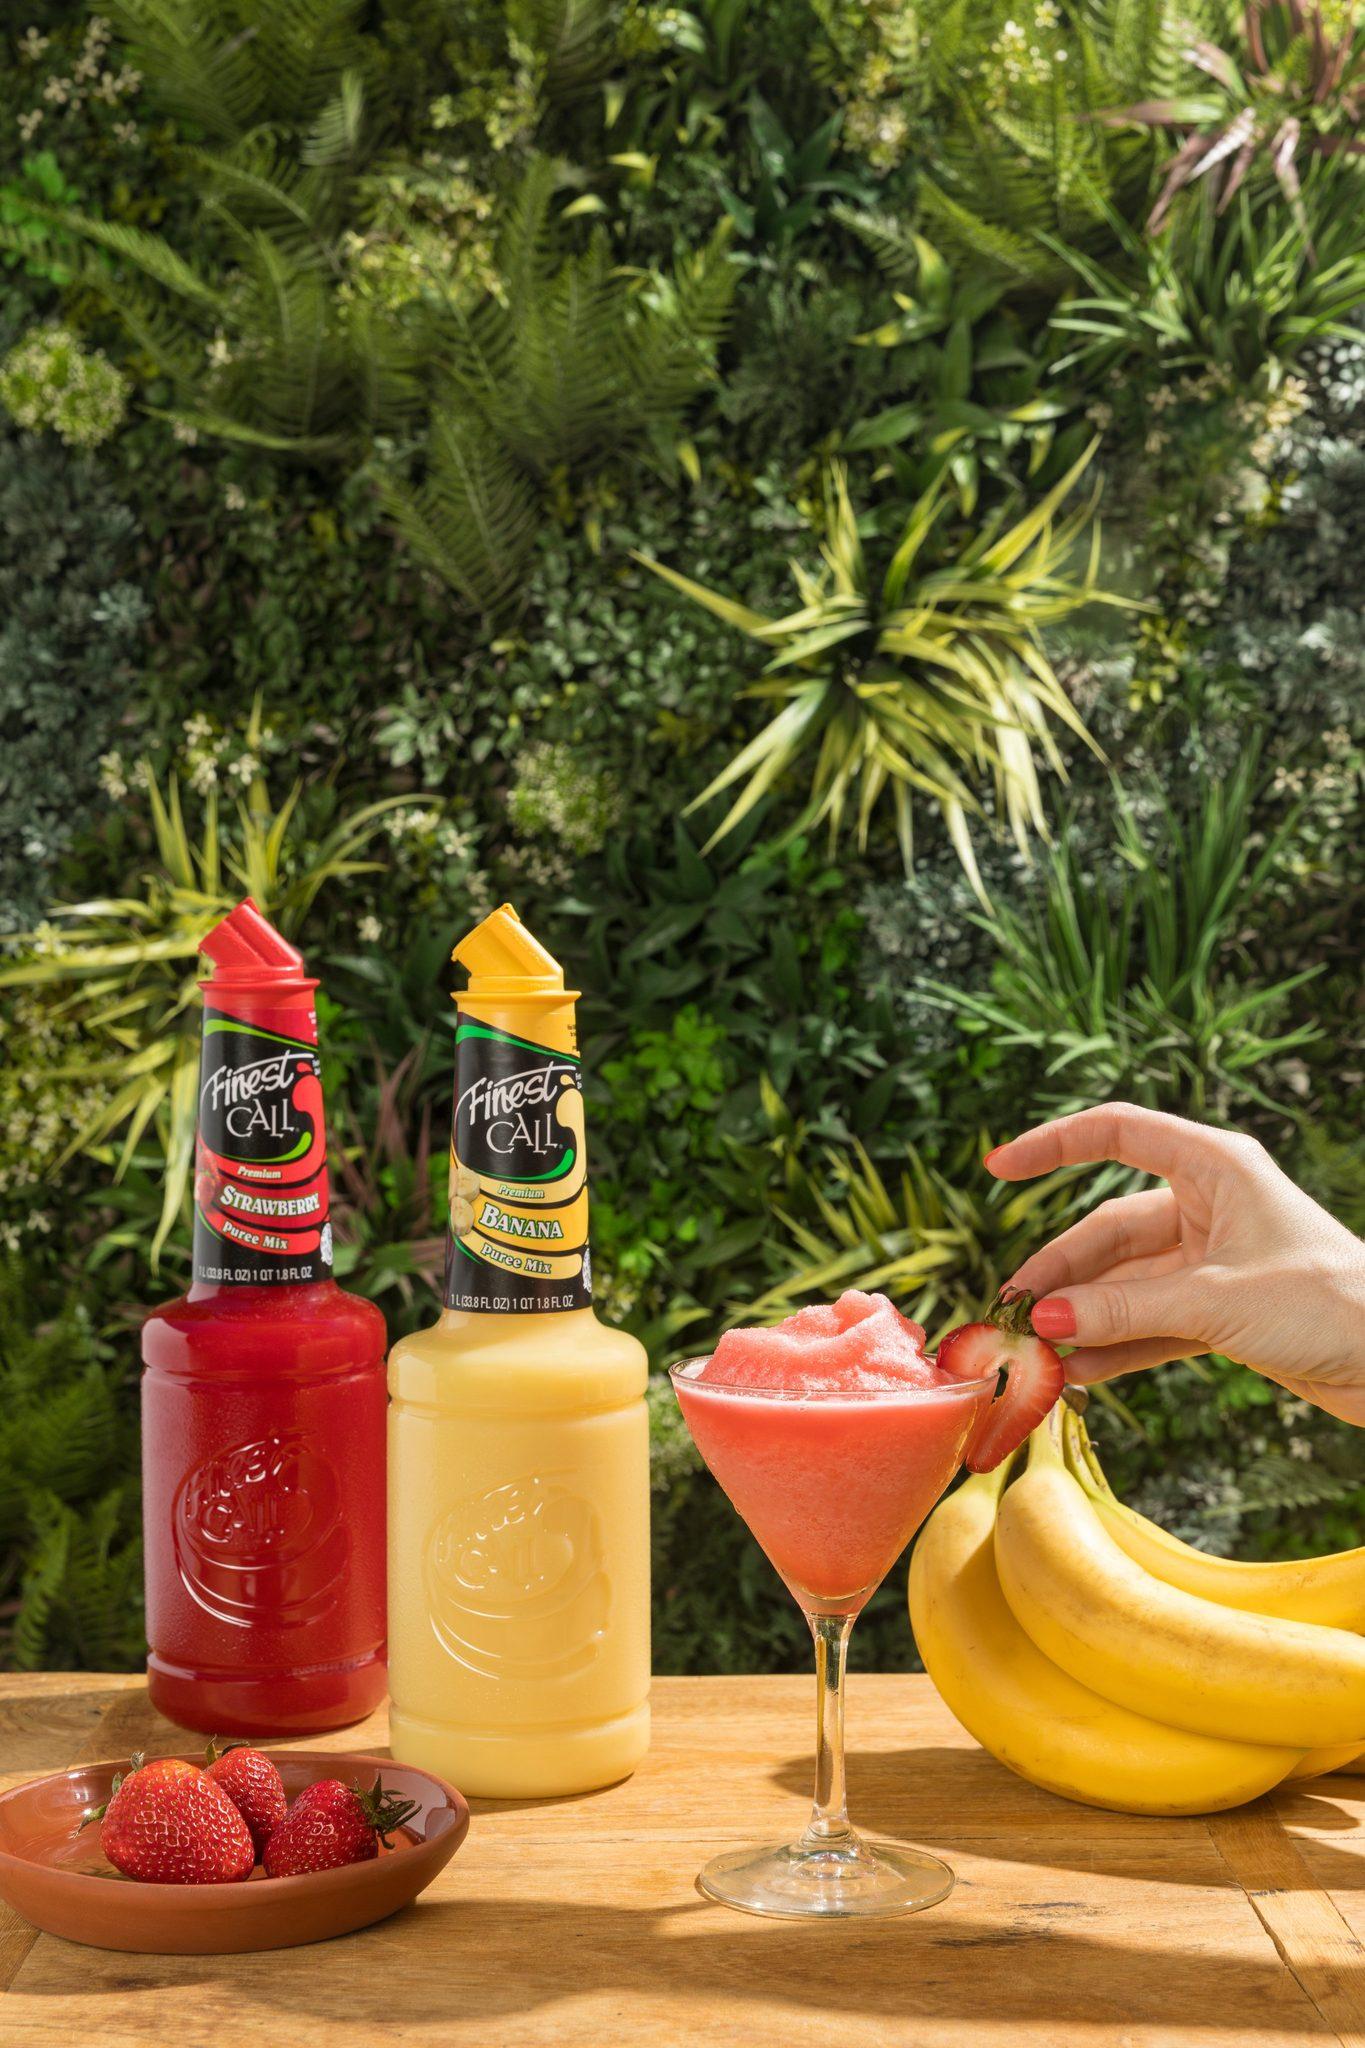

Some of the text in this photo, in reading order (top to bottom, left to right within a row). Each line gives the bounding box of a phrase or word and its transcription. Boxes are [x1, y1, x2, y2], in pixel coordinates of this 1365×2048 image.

[200, 1050, 314, 1111] Finest
[454, 1060, 576, 1125] Finest
[226, 1099, 295, 1138] CALL
[486, 1112, 558, 1155] CALL
[237, 1165, 281, 1179] Premium
[498, 1184, 545, 1198] Premium
[222, 1221, 288, 1250] Puree Mix
[479, 1203, 563, 1238] BANANA
[224, 1268, 234, 1280] FL
[235, 1268, 251, 1282] OZ)
[260, 1269, 274, 1281] QT
[276, 1268, 289, 1280] 1.8
[290, 1267, 300, 1279] FL
[300, 1265, 312, 1279] OZ
[481, 1243, 552, 1274] Puree Mix
[461, 1294, 479, 1309] (33.8
[480, 1296, 491, 1309] FL
[492, 1296, 510, 1311] OZ)
[520, 1297, 535, 1310] QT
[536, 1297, 550, 1309] 1.8
[551, 1296, 561, 1309] FL
[562, 1294, 574, 1308] OZ
